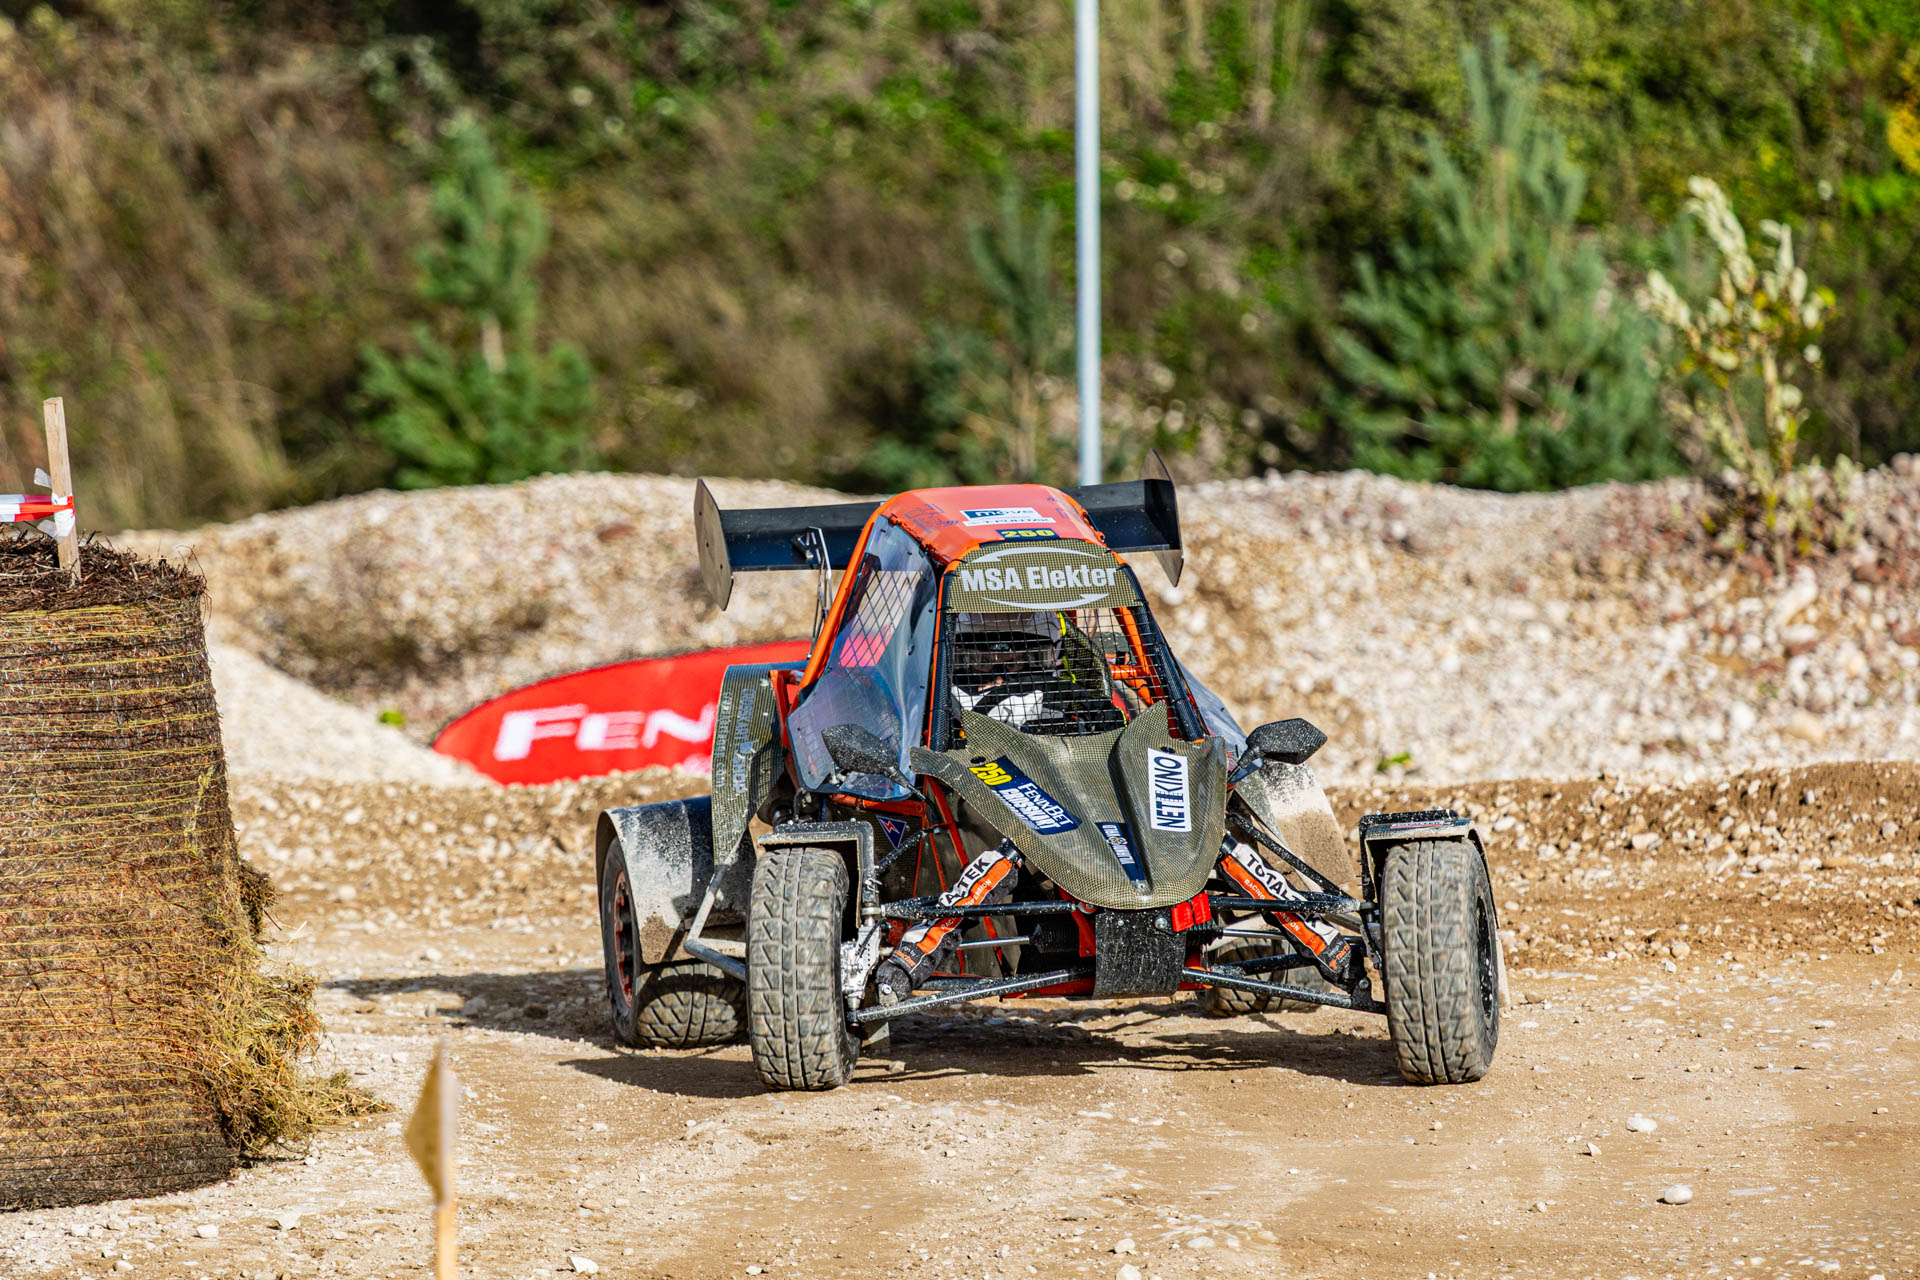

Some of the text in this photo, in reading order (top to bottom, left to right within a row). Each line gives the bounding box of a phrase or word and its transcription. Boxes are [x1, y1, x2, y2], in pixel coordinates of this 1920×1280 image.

[1001, 529, 1055, 538] 250
[960, 564, 1118, 592] MSA Elekter
[731, 749, 748, 794] SHOP
[968, 762, 1013, 786] 250
